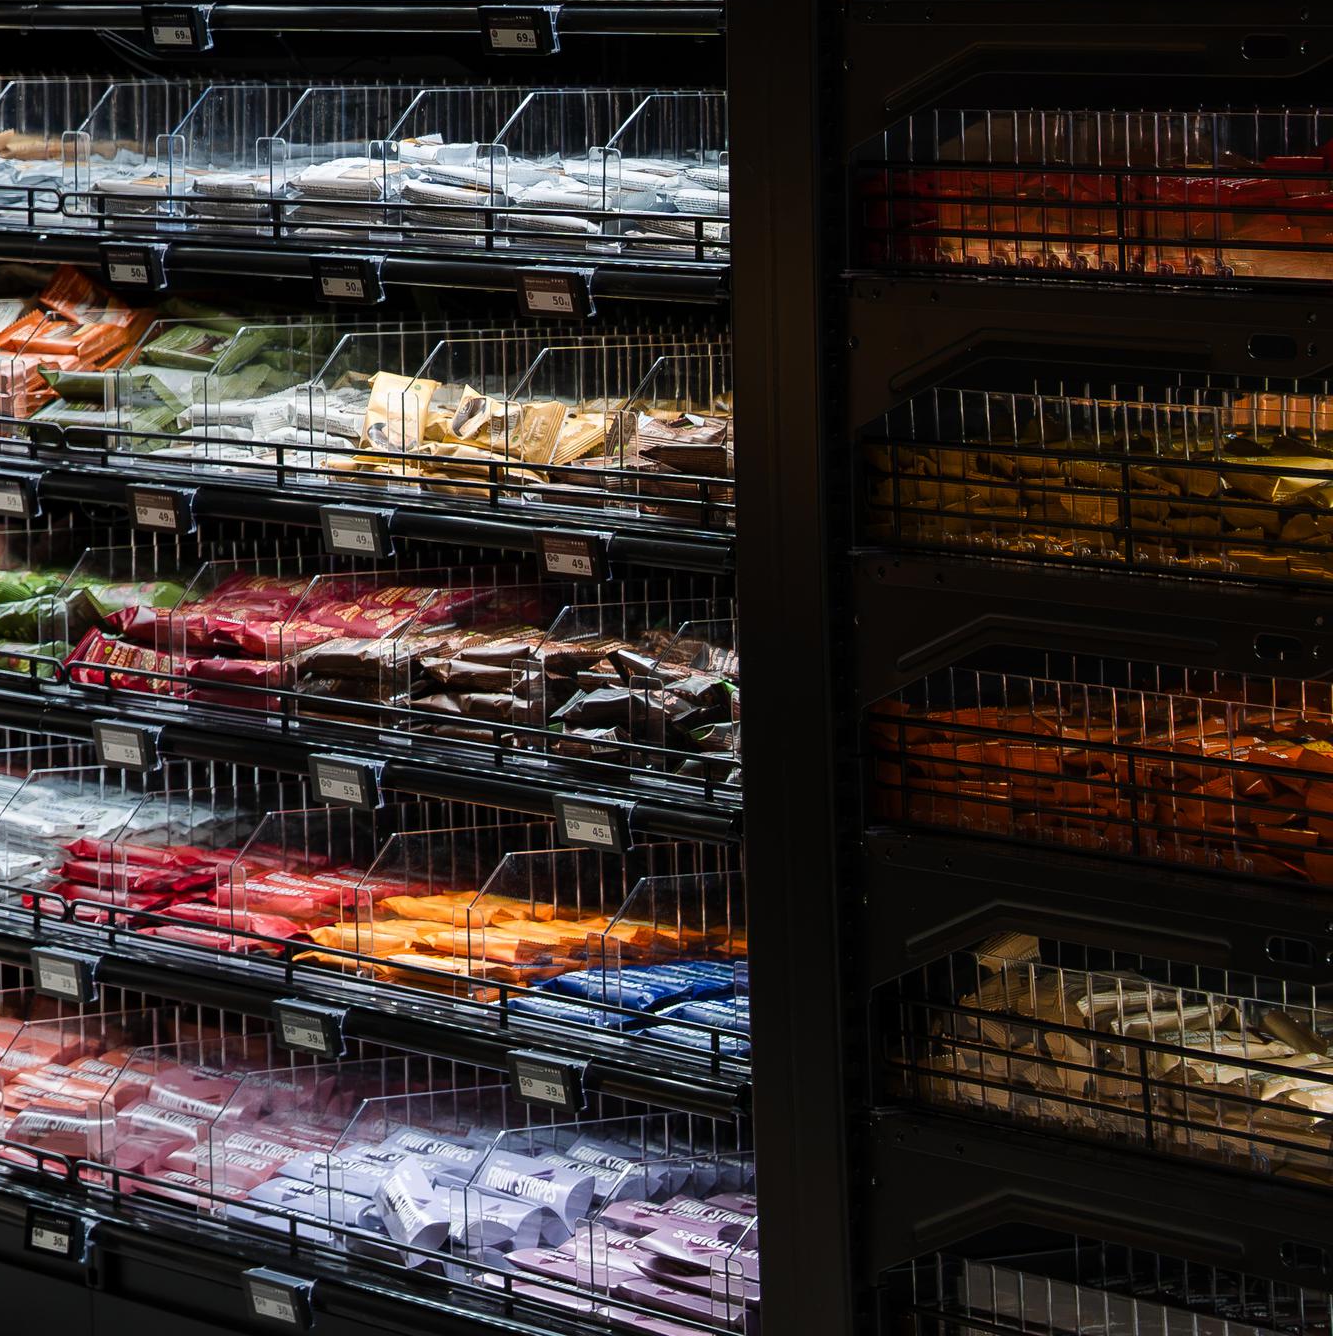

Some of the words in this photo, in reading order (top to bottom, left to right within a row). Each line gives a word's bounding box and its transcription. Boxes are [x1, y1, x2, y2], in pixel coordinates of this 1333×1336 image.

[175, 30, 185, 40] 69
[516, 32, 528, 43] 69
[131, 268, 141, 278] 50
[345, 282, 356, 292] 50
[553, 295, 564, 306] 50
[158, 511, 169, 521] 49
[356, 534, 367, 544] 49
[572, 558, 584, 569] 49
[343, 785, 354, 796] 55
[592, 826, 604, 838] 45
[307, 1032, 318, 1043] 39
[545, 1085, 557, 1096] 39
[49, 1120, 90, 1134] STRIPE
[225, 1133, 259, 1152] FRUIT
[397, 1133, 432, 1151] FRUIT
[431, 1140, 478, 1163] STRIPES
[573, 1146, 610, 1165] FRUIT
[486, 1167, 517, 1192] FRUIT
[515, 1174, 561, 1204] STRIPES
[673, 1200, 715, 1216] FRUIT
